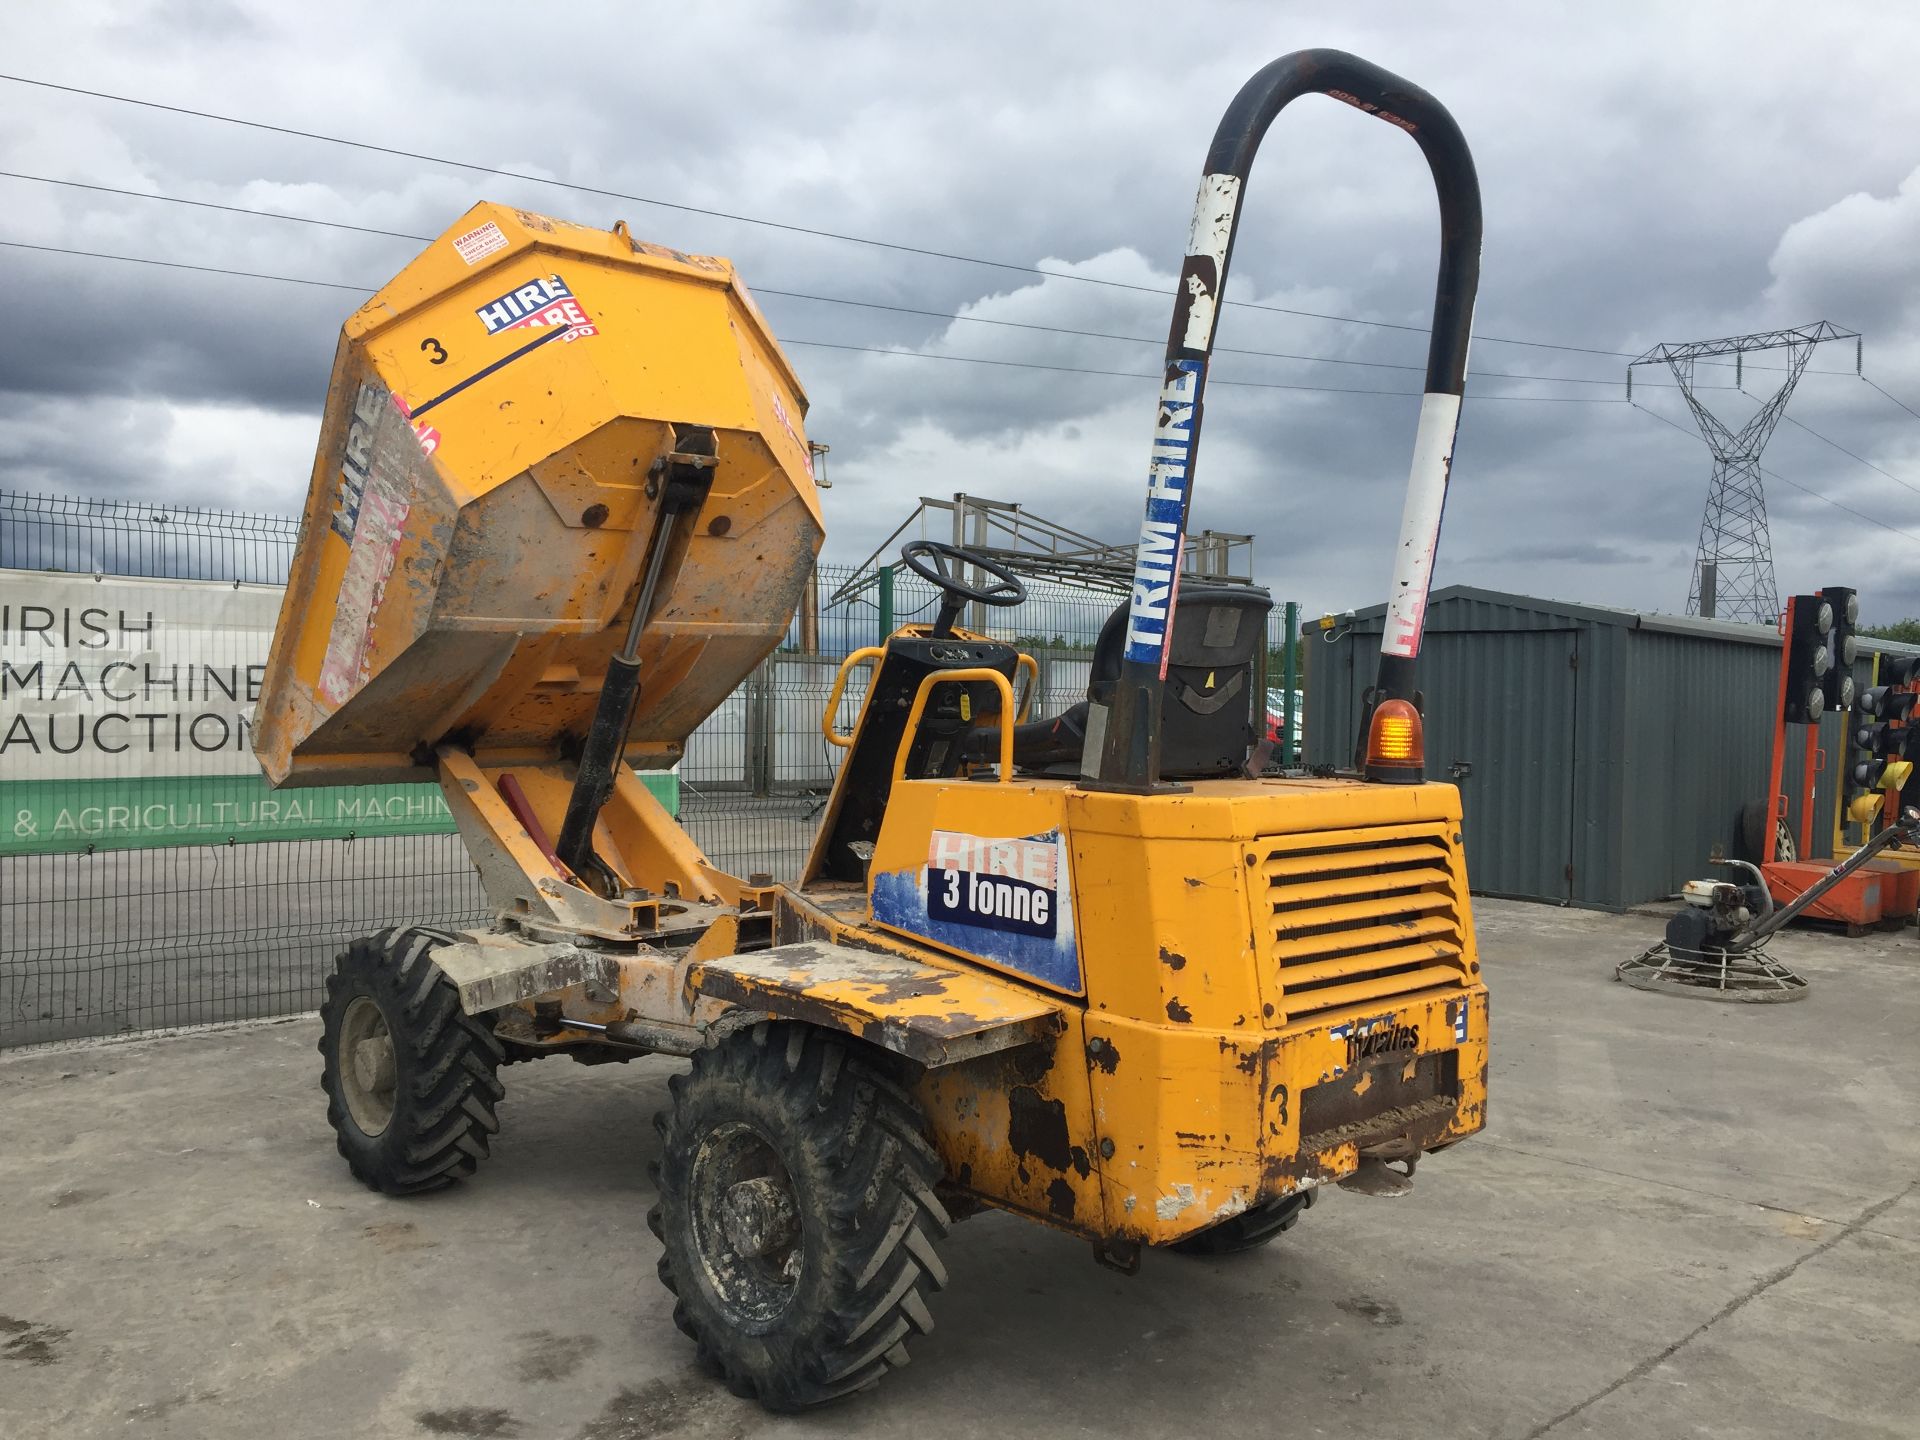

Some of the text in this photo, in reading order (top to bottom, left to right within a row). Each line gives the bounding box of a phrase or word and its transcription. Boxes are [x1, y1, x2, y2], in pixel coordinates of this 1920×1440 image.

[478, 274, 567, 331] HIRE
[421, 337, 448, 364] 3
[1149, 368, 1198, 502] HIRE
[1125, 520, 1178, 659] TRIM
[3, 605, 153, 651] IRISH
[14, 809, 38, 837] &
[51, 799, 322, 834] AGRICULTURAL
[936, 836, 1049, 887] HIRE
[943, 868, 1049, 925] 3 tonne
[1269, 1084, 1288, 1136] 3
